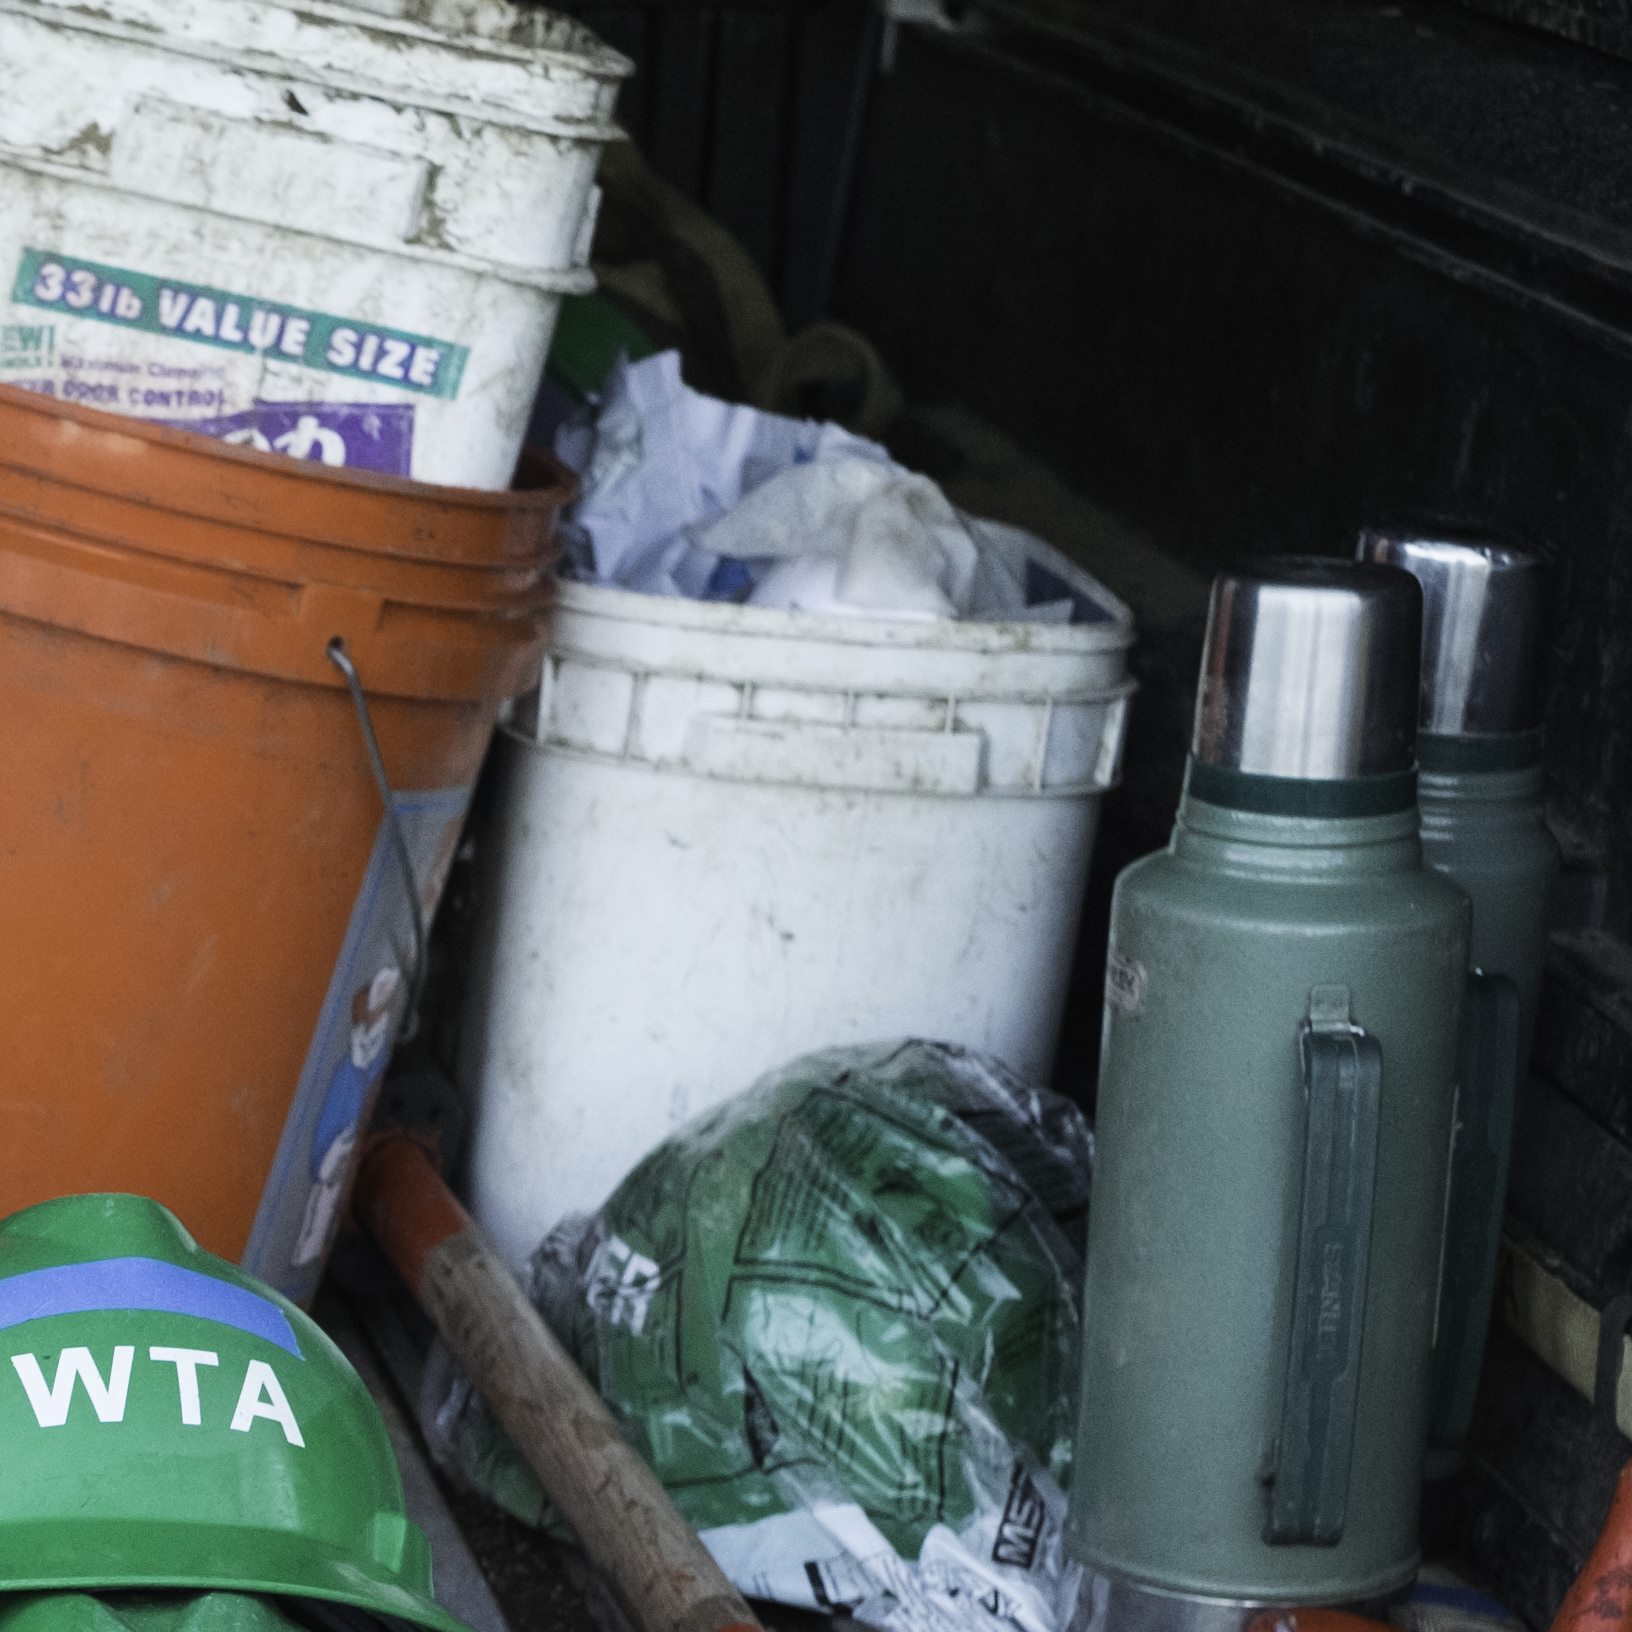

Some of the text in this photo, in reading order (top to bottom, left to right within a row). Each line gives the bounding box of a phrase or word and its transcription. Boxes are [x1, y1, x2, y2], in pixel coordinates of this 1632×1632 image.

[157, 286, 311, 357] VALUE
[325, 328, 441, 387] SIZE
[10, 1345, 307, 1448] WTA
